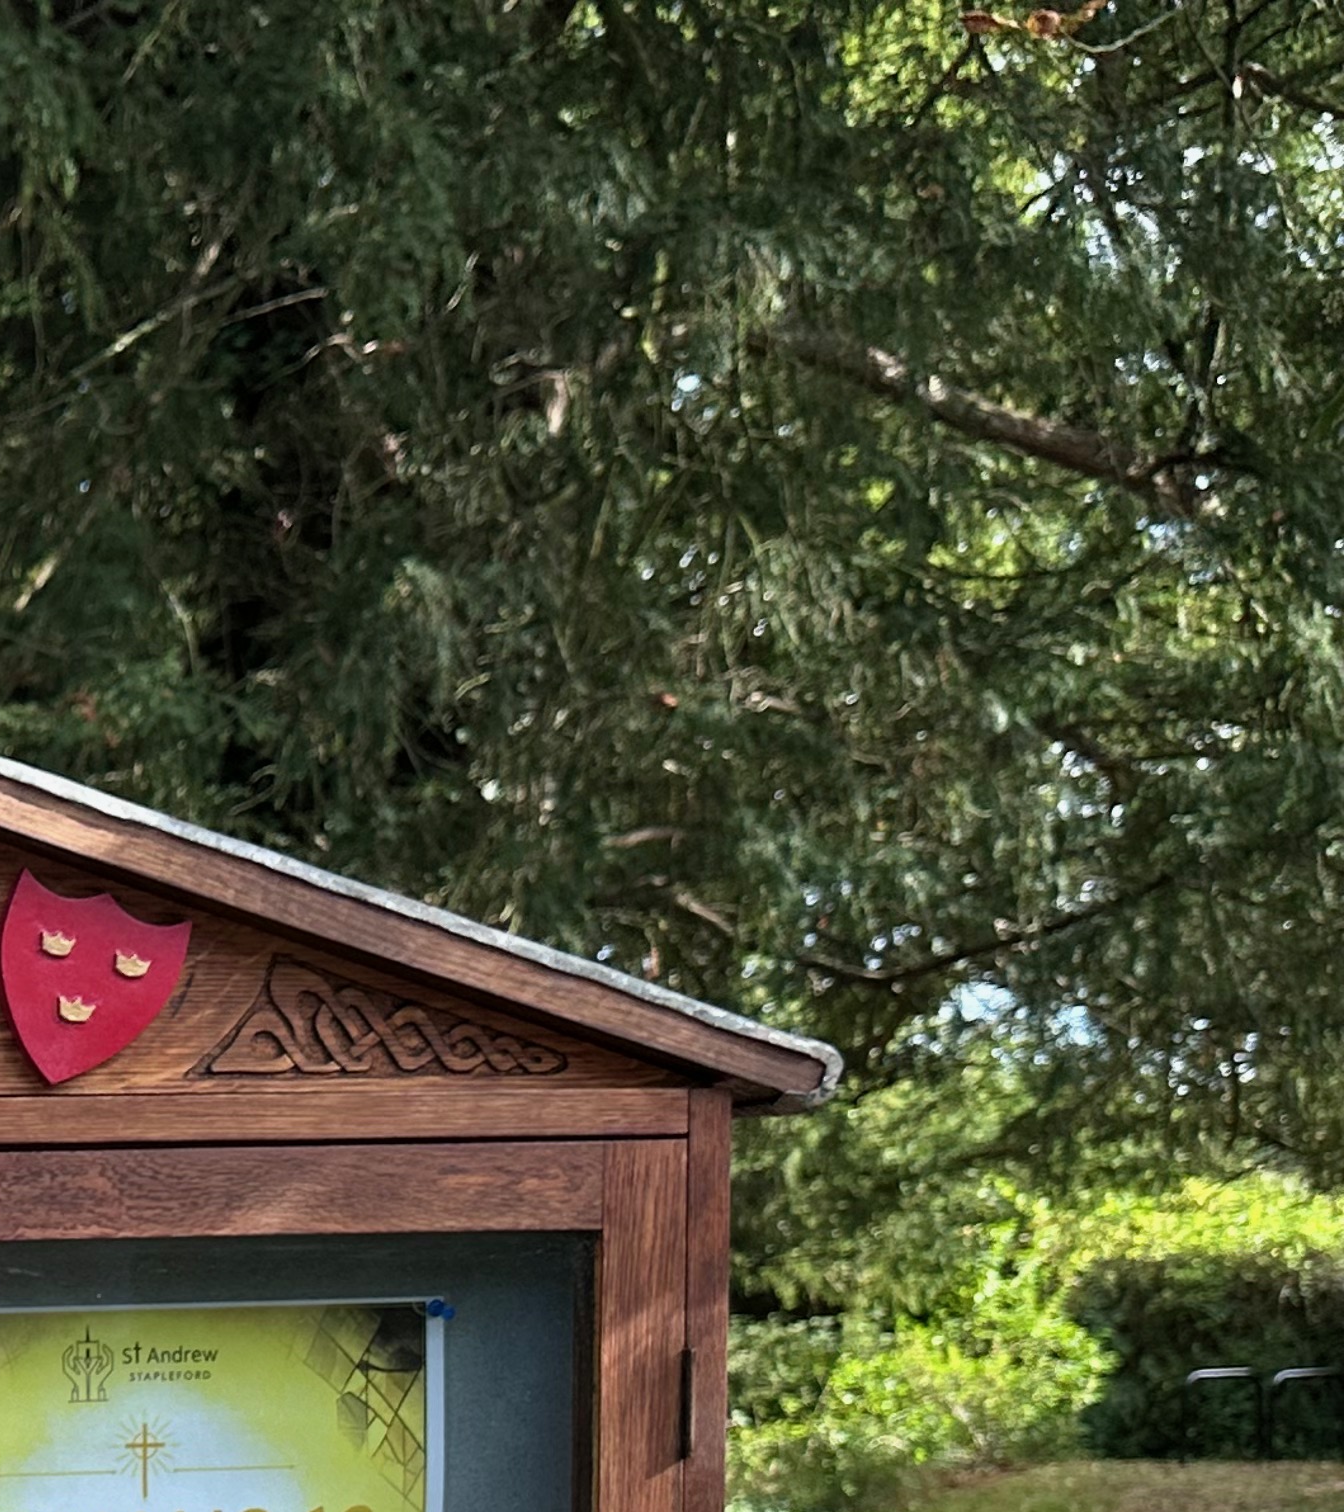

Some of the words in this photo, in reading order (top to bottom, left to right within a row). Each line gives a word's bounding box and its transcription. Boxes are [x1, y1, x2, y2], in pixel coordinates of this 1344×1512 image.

[122, 1341, 142, 1364] St
[146, 1345, 219, 1363] Andrew
[129, 1370, 212, 1382] STAPLEFORD
